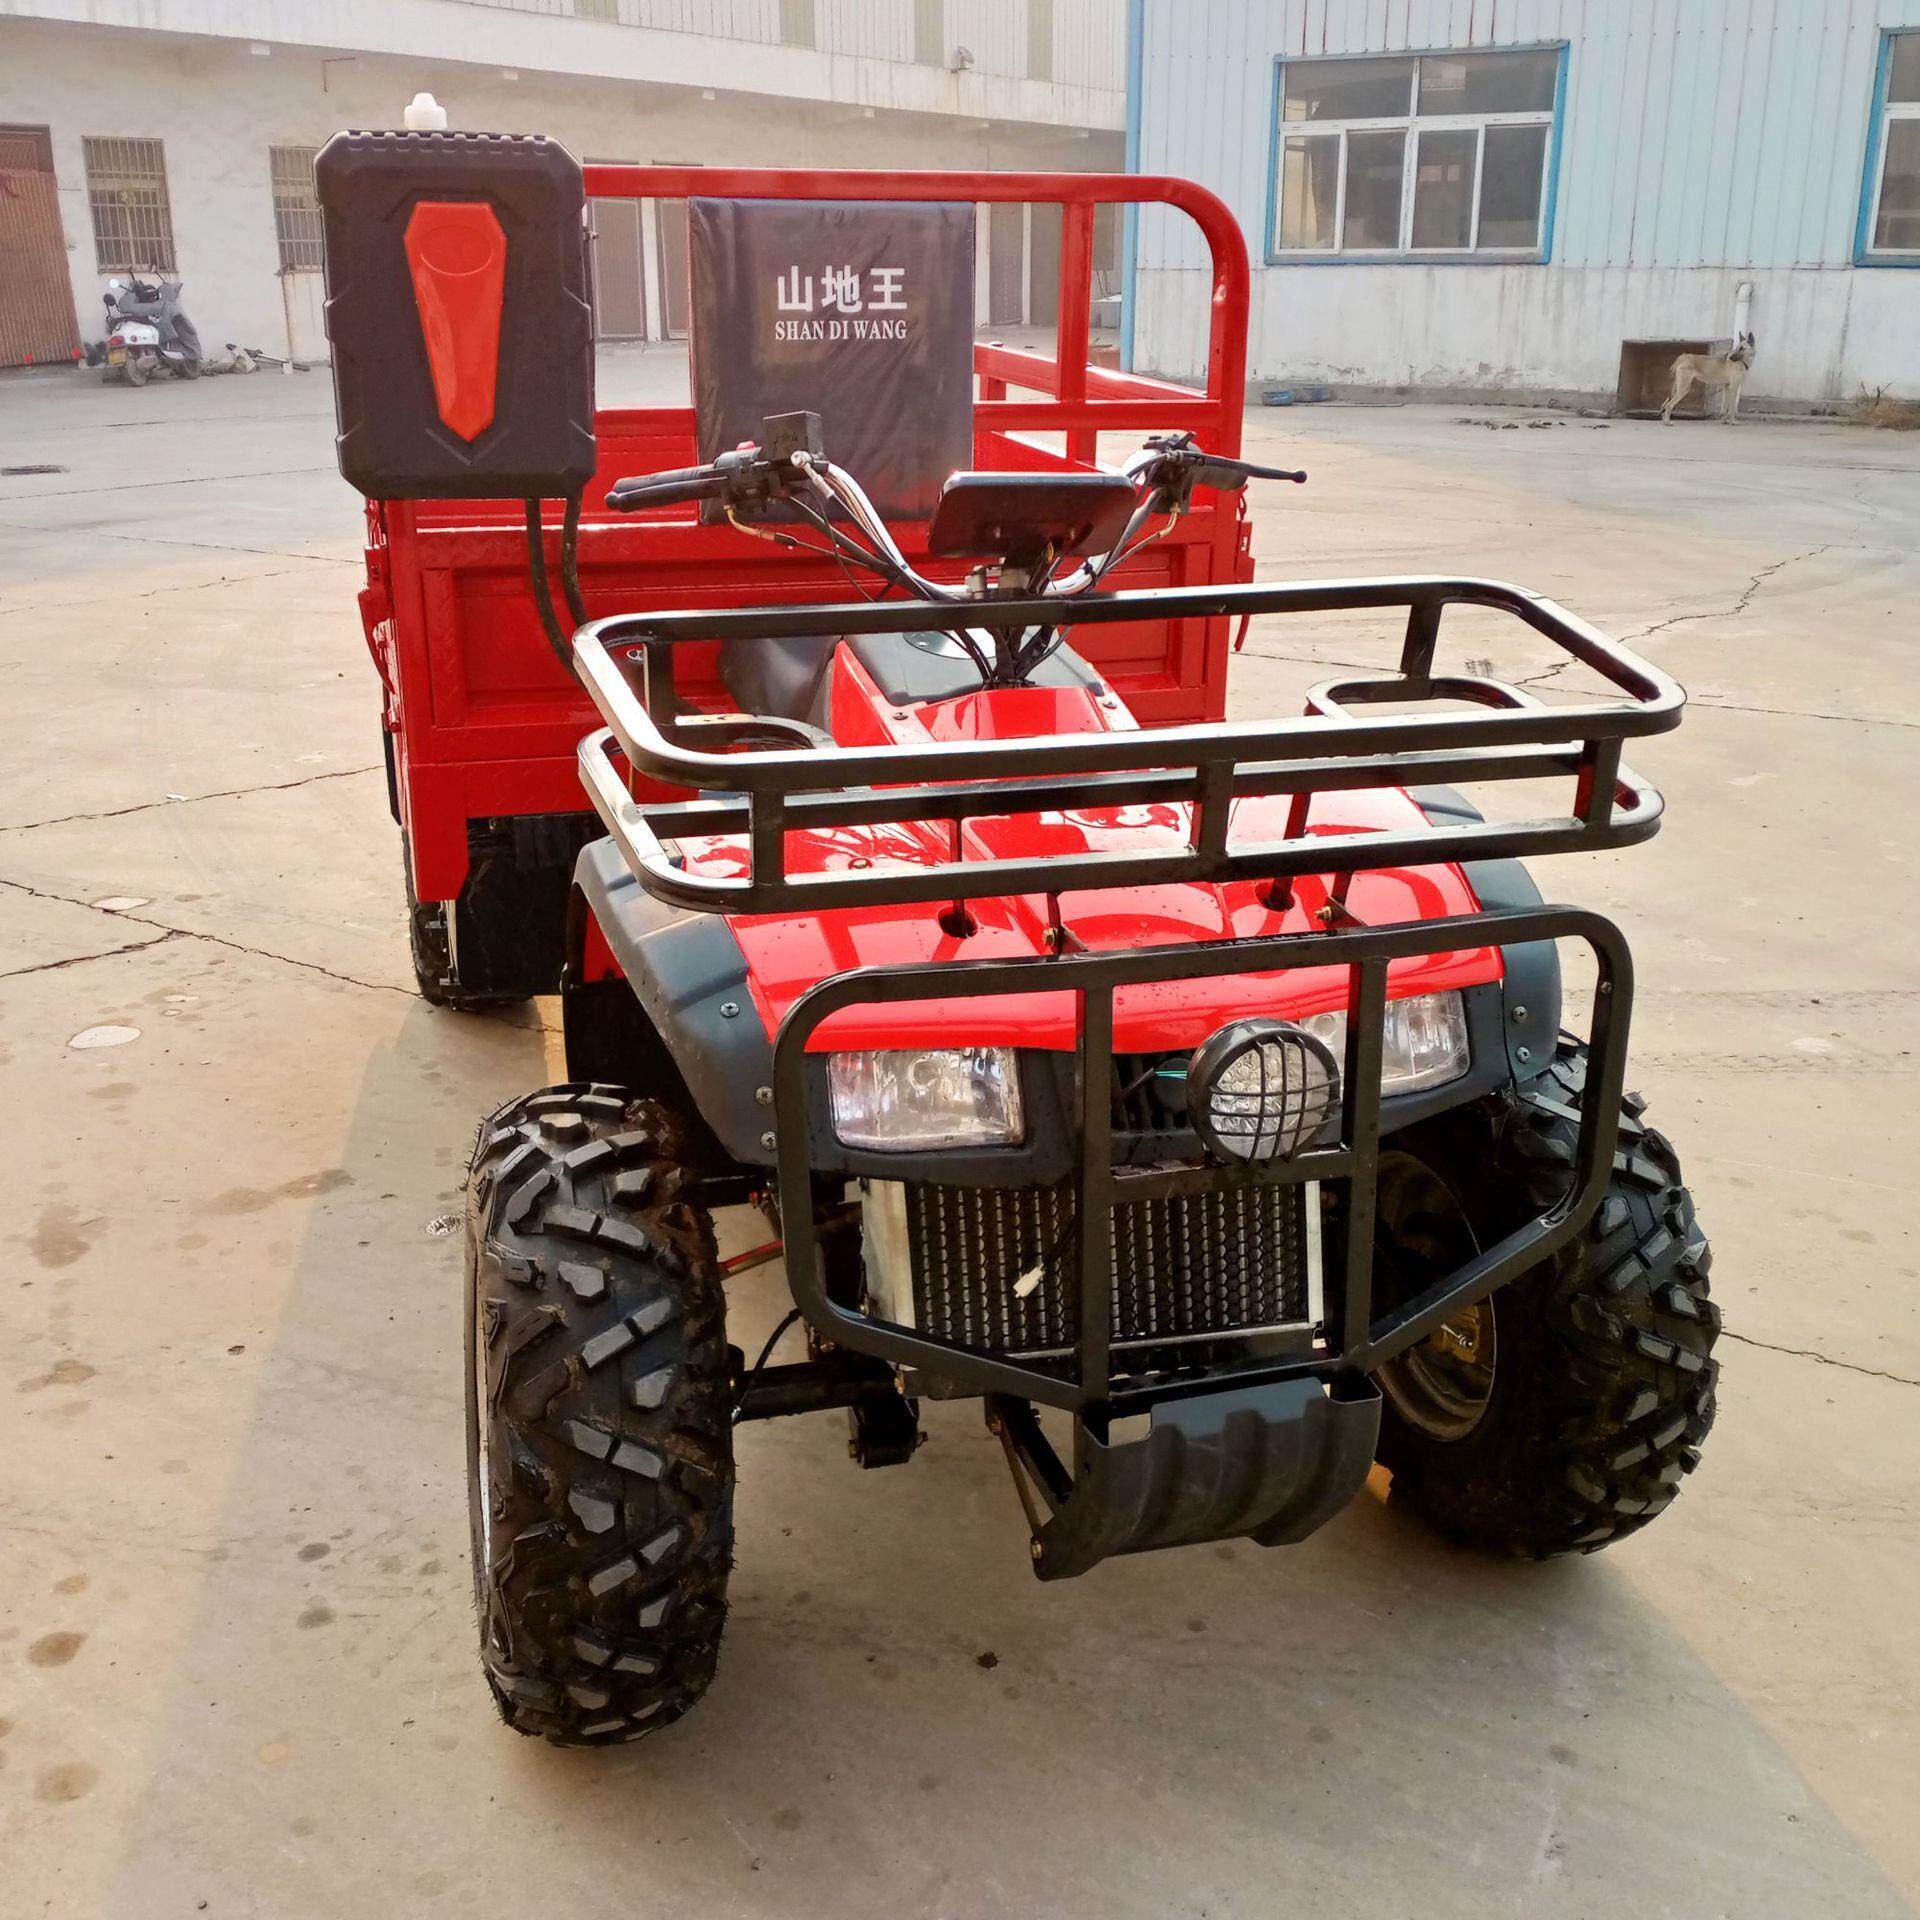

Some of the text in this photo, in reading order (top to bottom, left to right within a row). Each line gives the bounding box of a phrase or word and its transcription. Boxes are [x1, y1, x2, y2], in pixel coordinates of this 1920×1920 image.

[777, 264, 907, 313] 山地王
[774, 320, 907, 340] SHAN DI WANG
